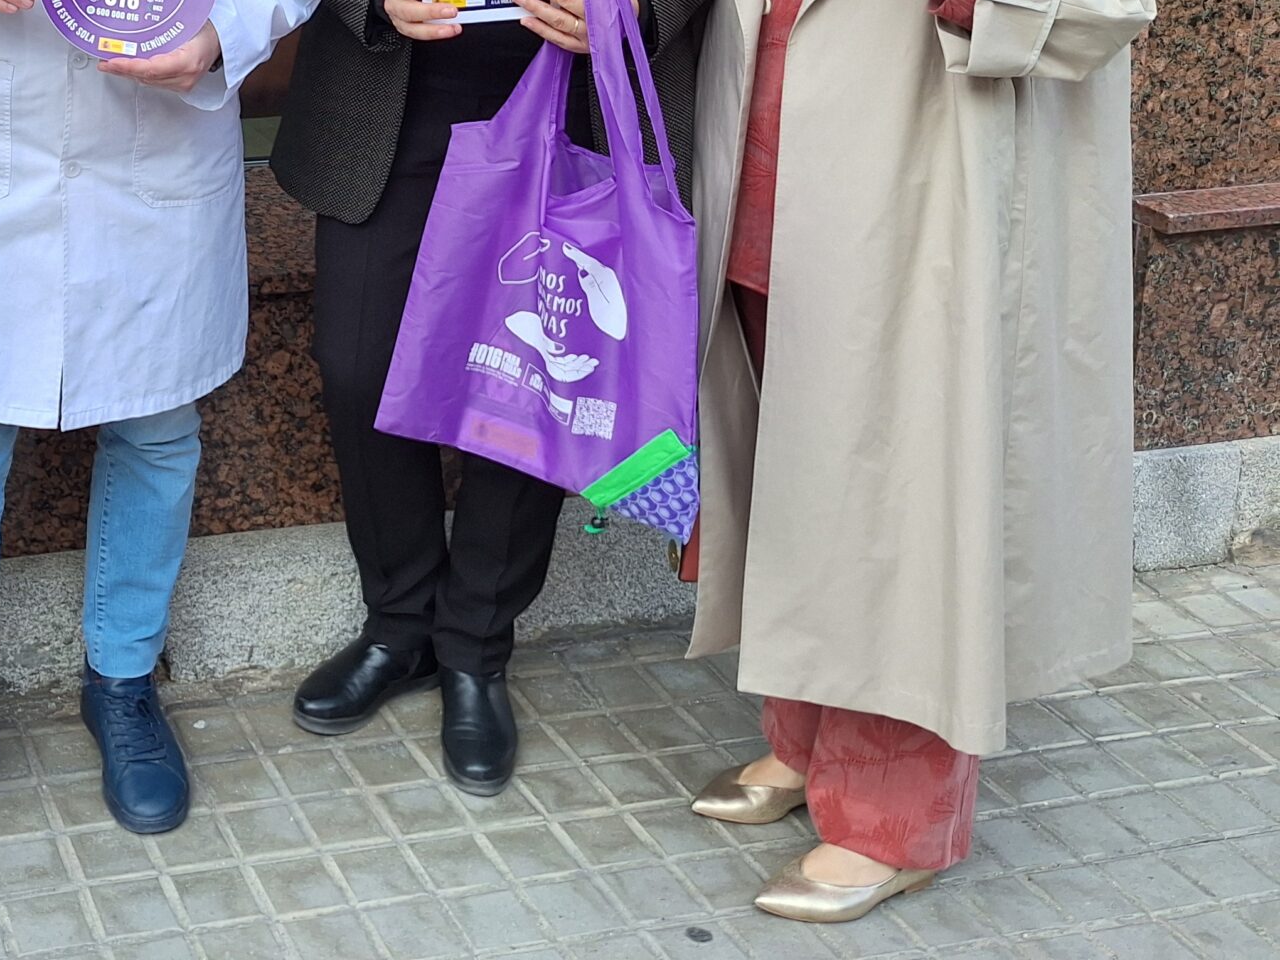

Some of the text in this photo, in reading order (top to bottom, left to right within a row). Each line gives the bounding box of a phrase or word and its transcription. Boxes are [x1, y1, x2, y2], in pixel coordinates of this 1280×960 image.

[57, 5, 78, 31] ESTÁS
[76, 26, 96, 44] SOLA
[96, 7, 139, 22] 600 000 016
[140, 21, 185, 52] DENÚNCIALO
